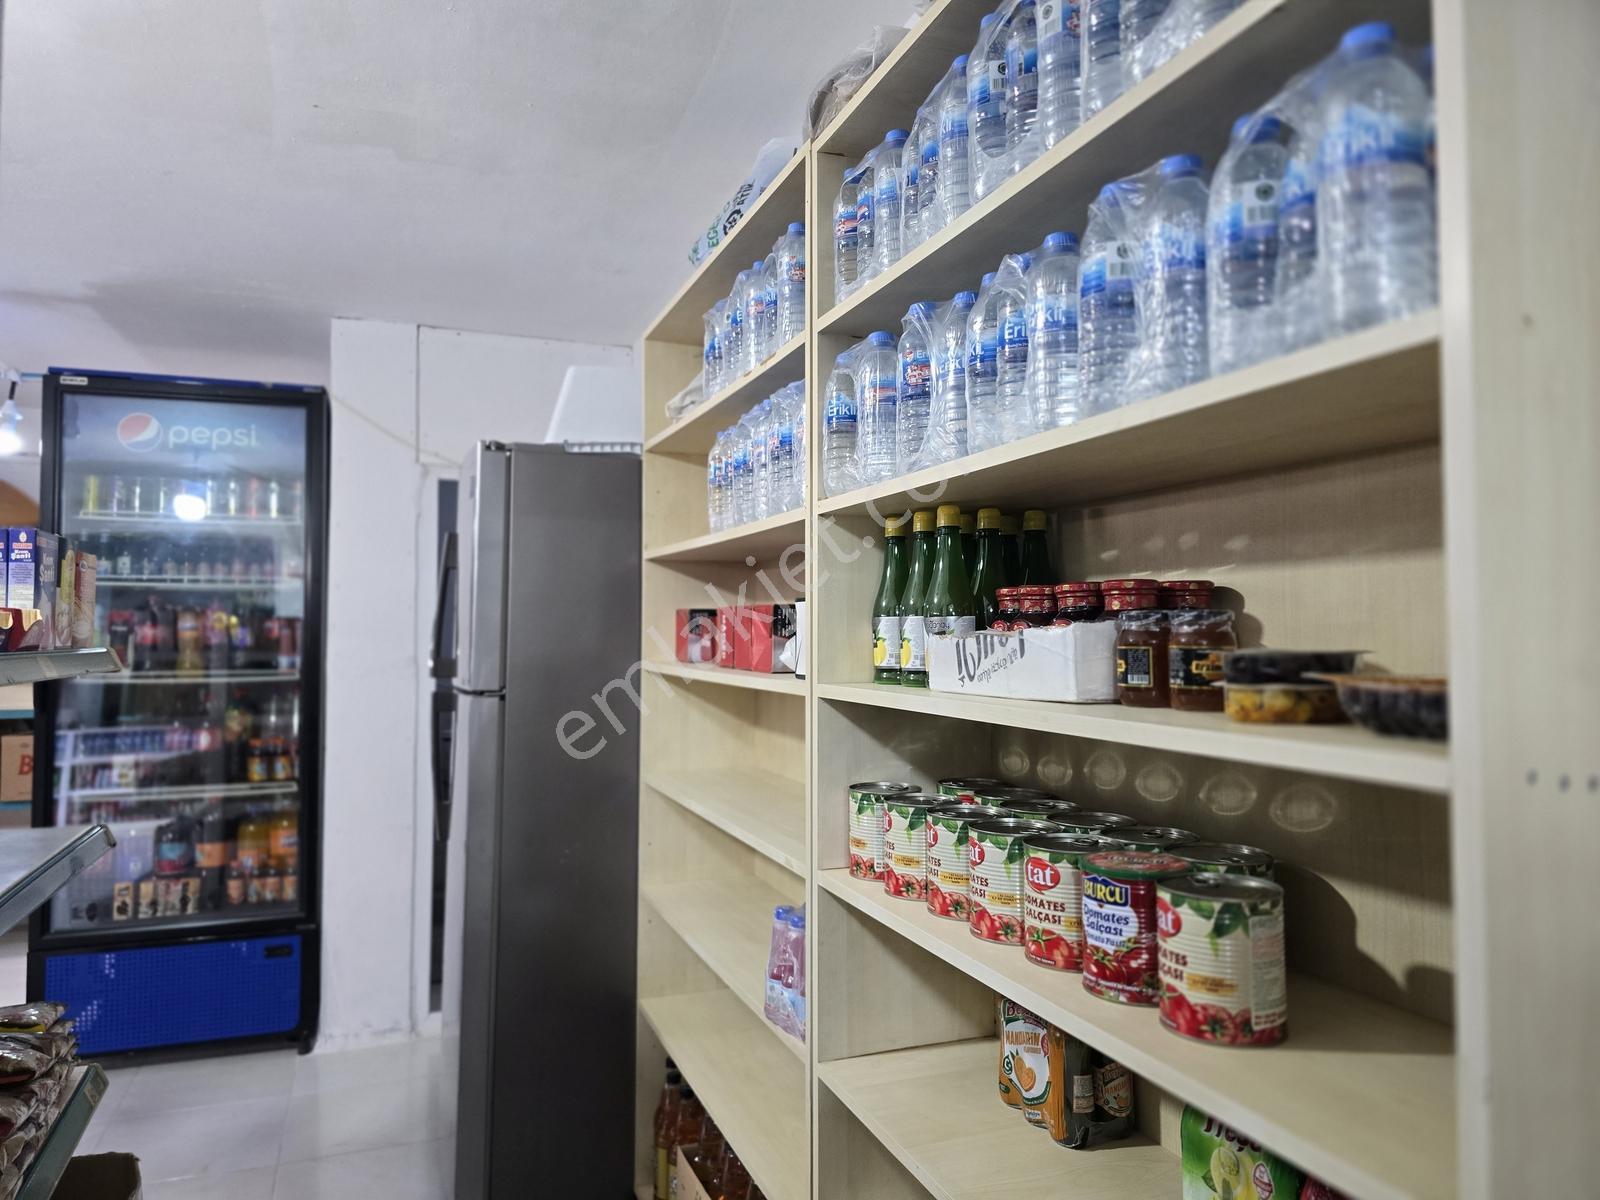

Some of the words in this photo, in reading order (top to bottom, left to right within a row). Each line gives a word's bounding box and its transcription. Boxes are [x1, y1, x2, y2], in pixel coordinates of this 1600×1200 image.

[168, 424, 257, 450] pepsi
[1027, 862, 1055, 887] tat
[1083, 879, 1126, 904] BURCU
